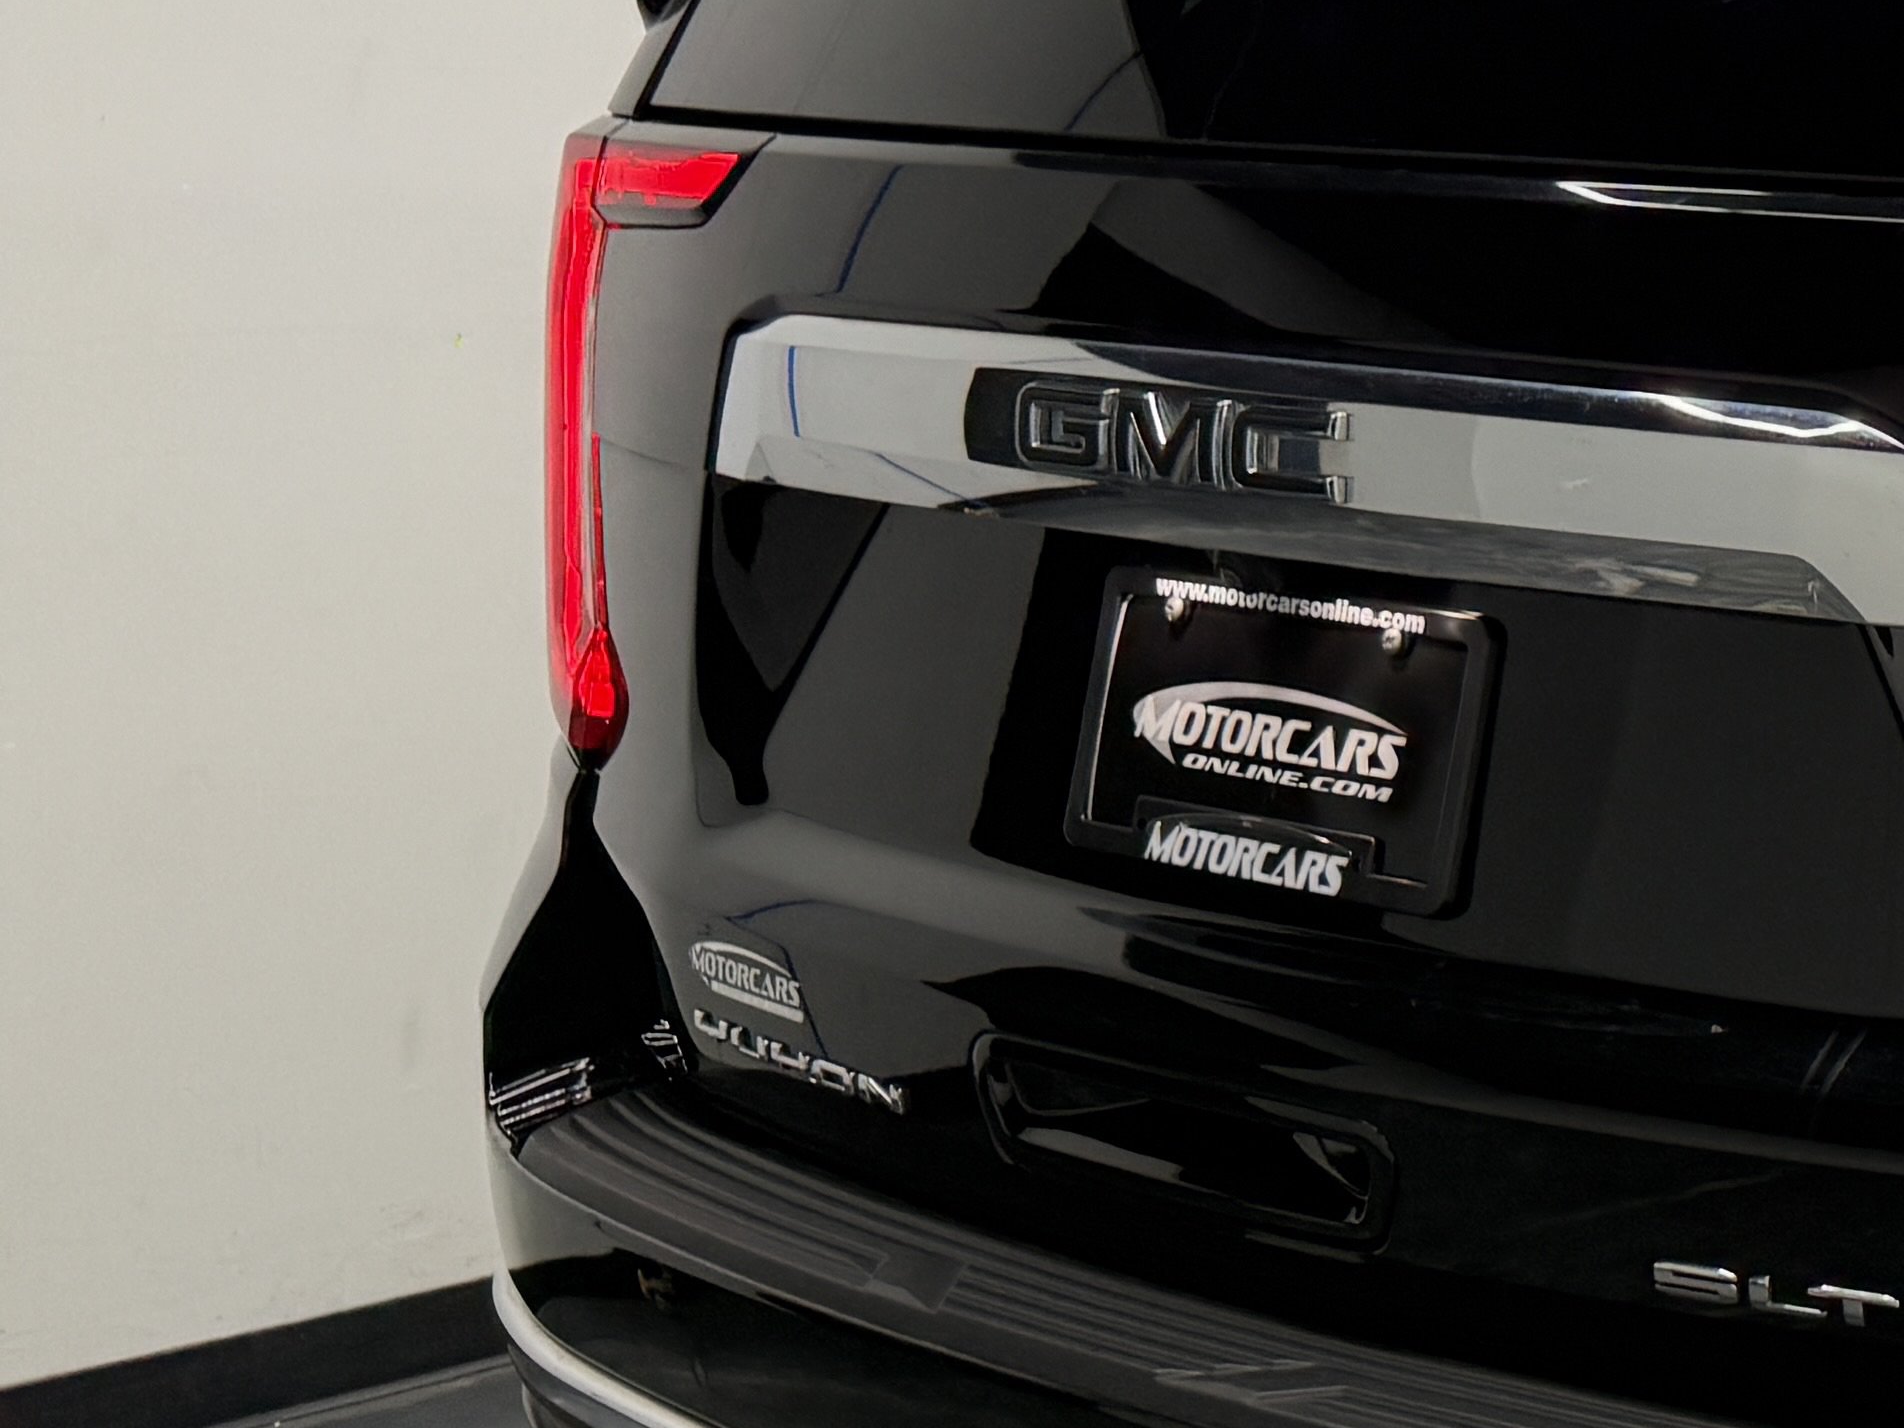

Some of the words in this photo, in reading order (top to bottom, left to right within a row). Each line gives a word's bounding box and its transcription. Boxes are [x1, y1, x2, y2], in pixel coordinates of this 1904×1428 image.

[1016, 380, 1352, 504] GMC
[1156, 577, 1426, 635] www.motorcarsonline.com
[1133, 694, 1408, 781] MOTORCARS
[1182, 752, 1394, 804] ONLINE.COM
[1144, 820, 1350, 898] MOTORCARS
[688, 944, 801, 1009] MOTORCARS
[1653, 1261, 1901, 1328] SLT
